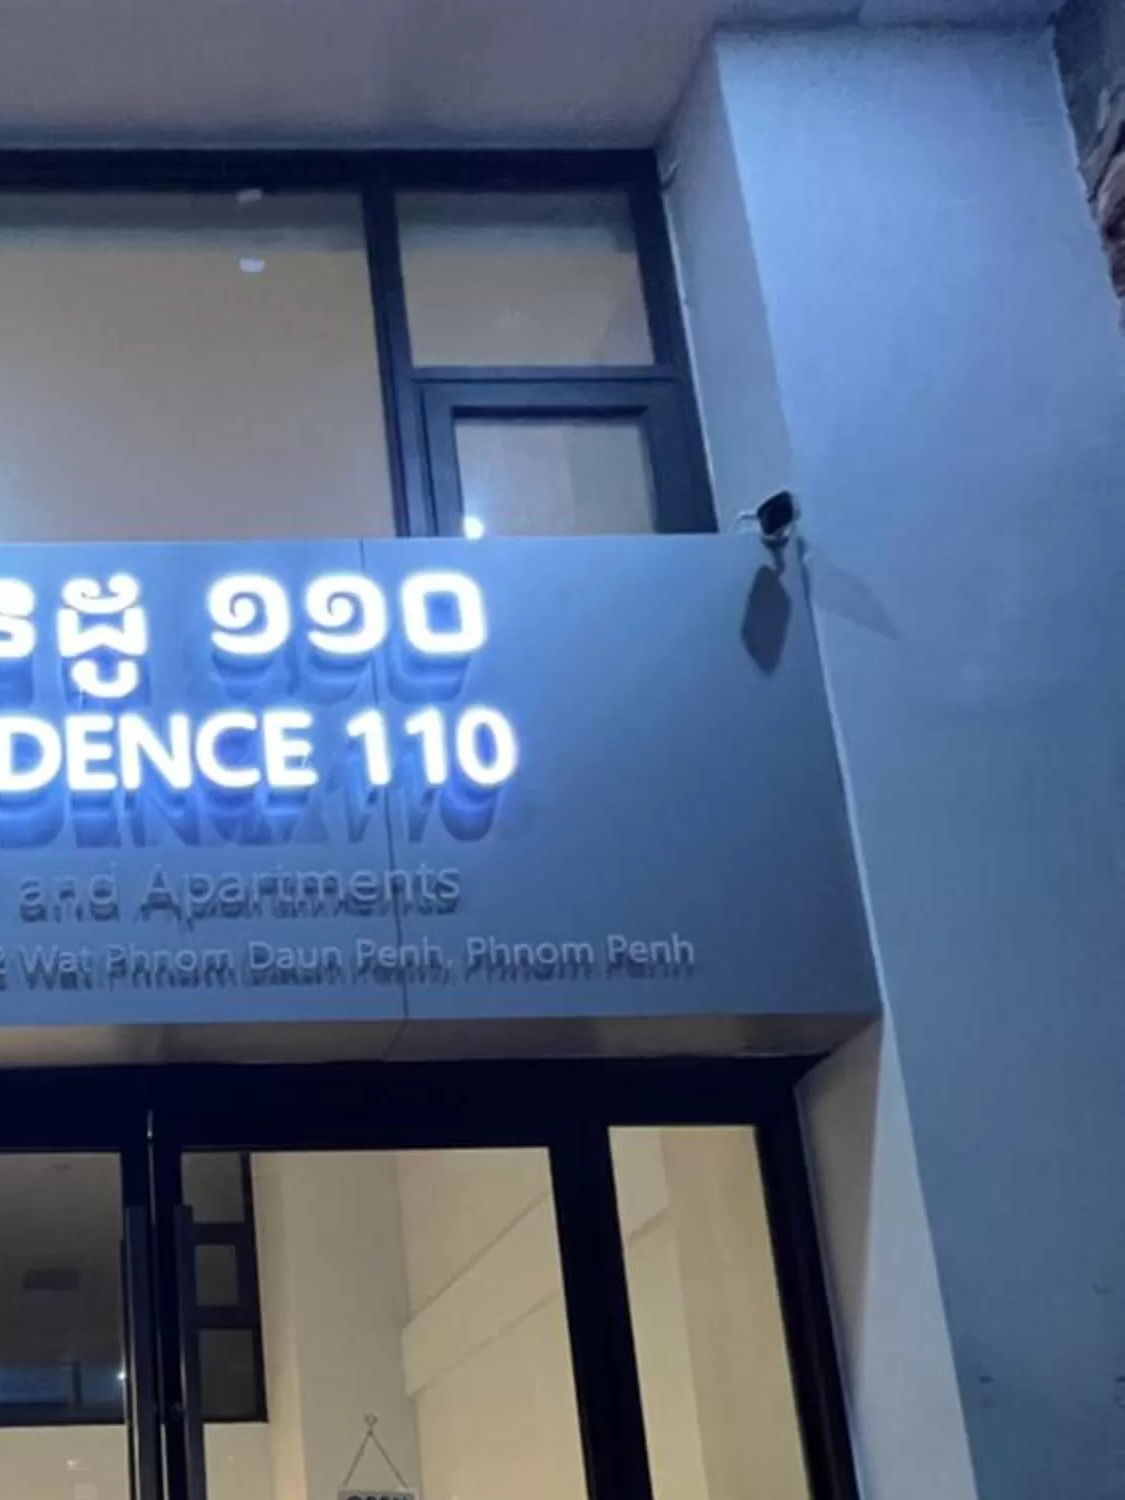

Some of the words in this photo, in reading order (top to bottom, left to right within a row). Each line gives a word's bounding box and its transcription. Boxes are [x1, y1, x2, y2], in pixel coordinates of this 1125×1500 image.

[346, 707, 520, 789] 110
[18, 861, 120, 913] and
[140, 862, 461, 913] Apartments
[19, 945, 93, 976] Wat
[105, 942, 242, 973] Phnom
[248, 941, 343, 972] Daun
[466, 936, 595, 967] Phnom
[607, 933, 695, 965] Penh
